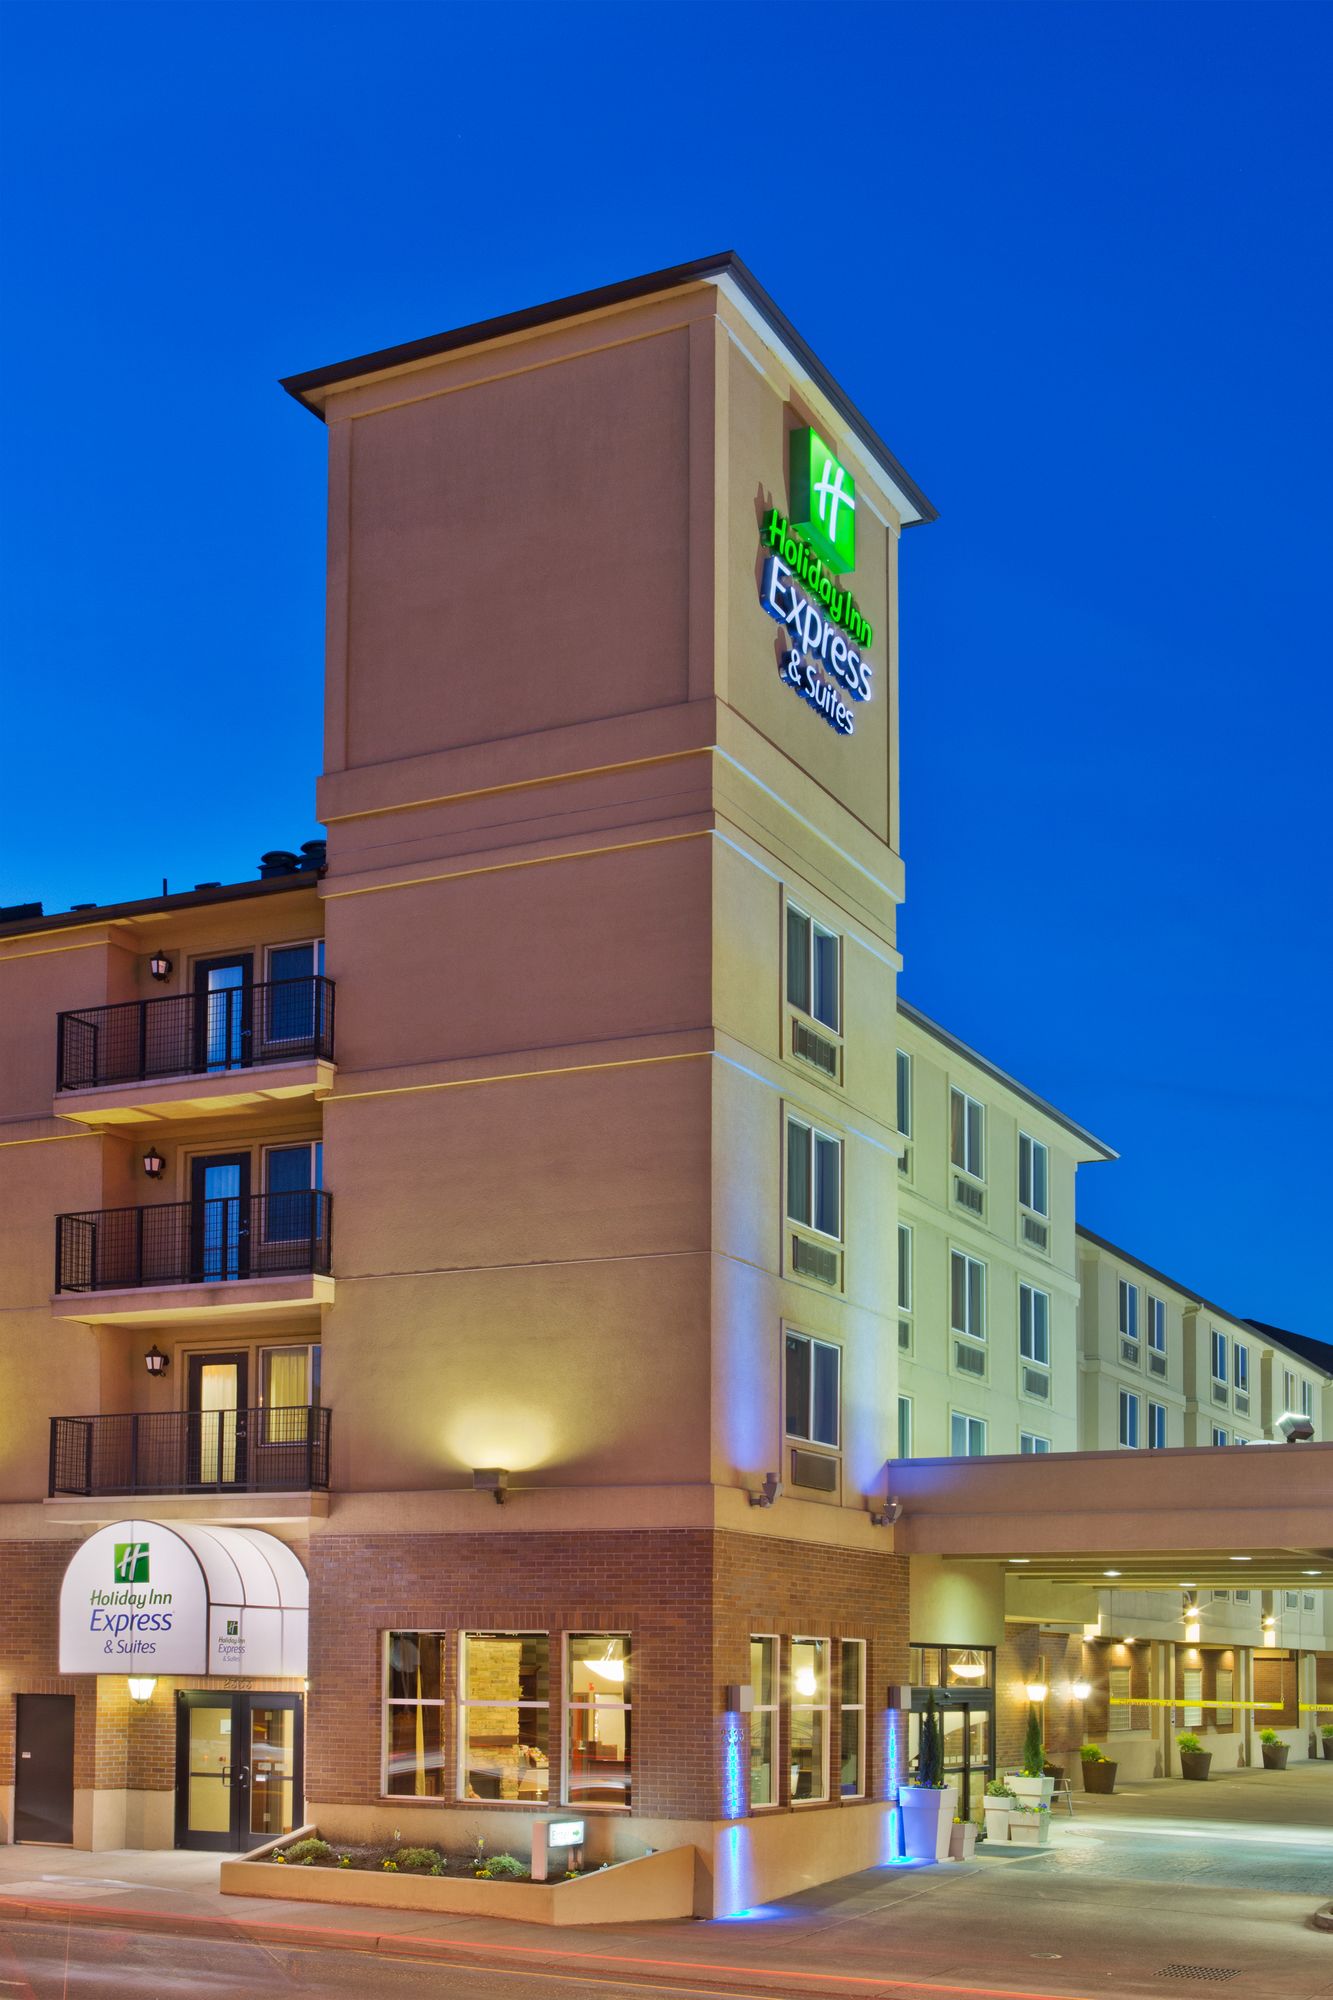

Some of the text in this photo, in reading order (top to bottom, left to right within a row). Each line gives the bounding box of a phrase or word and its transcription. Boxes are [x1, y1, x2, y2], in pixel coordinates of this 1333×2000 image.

[769, 508, 873, 649] Holiday Inn
[768, 555, 873, 702] Express
[787, 648, 855, 735] & Suites
[90, 1588, 173, 1610] Holiday Inn
[90, 1608, 174, 1638] Express
[103, 1639, 157, 1654] & Suites
[218, 1635, 238, 1645] Holiday
[218, 1643, 246, 1656] Express
